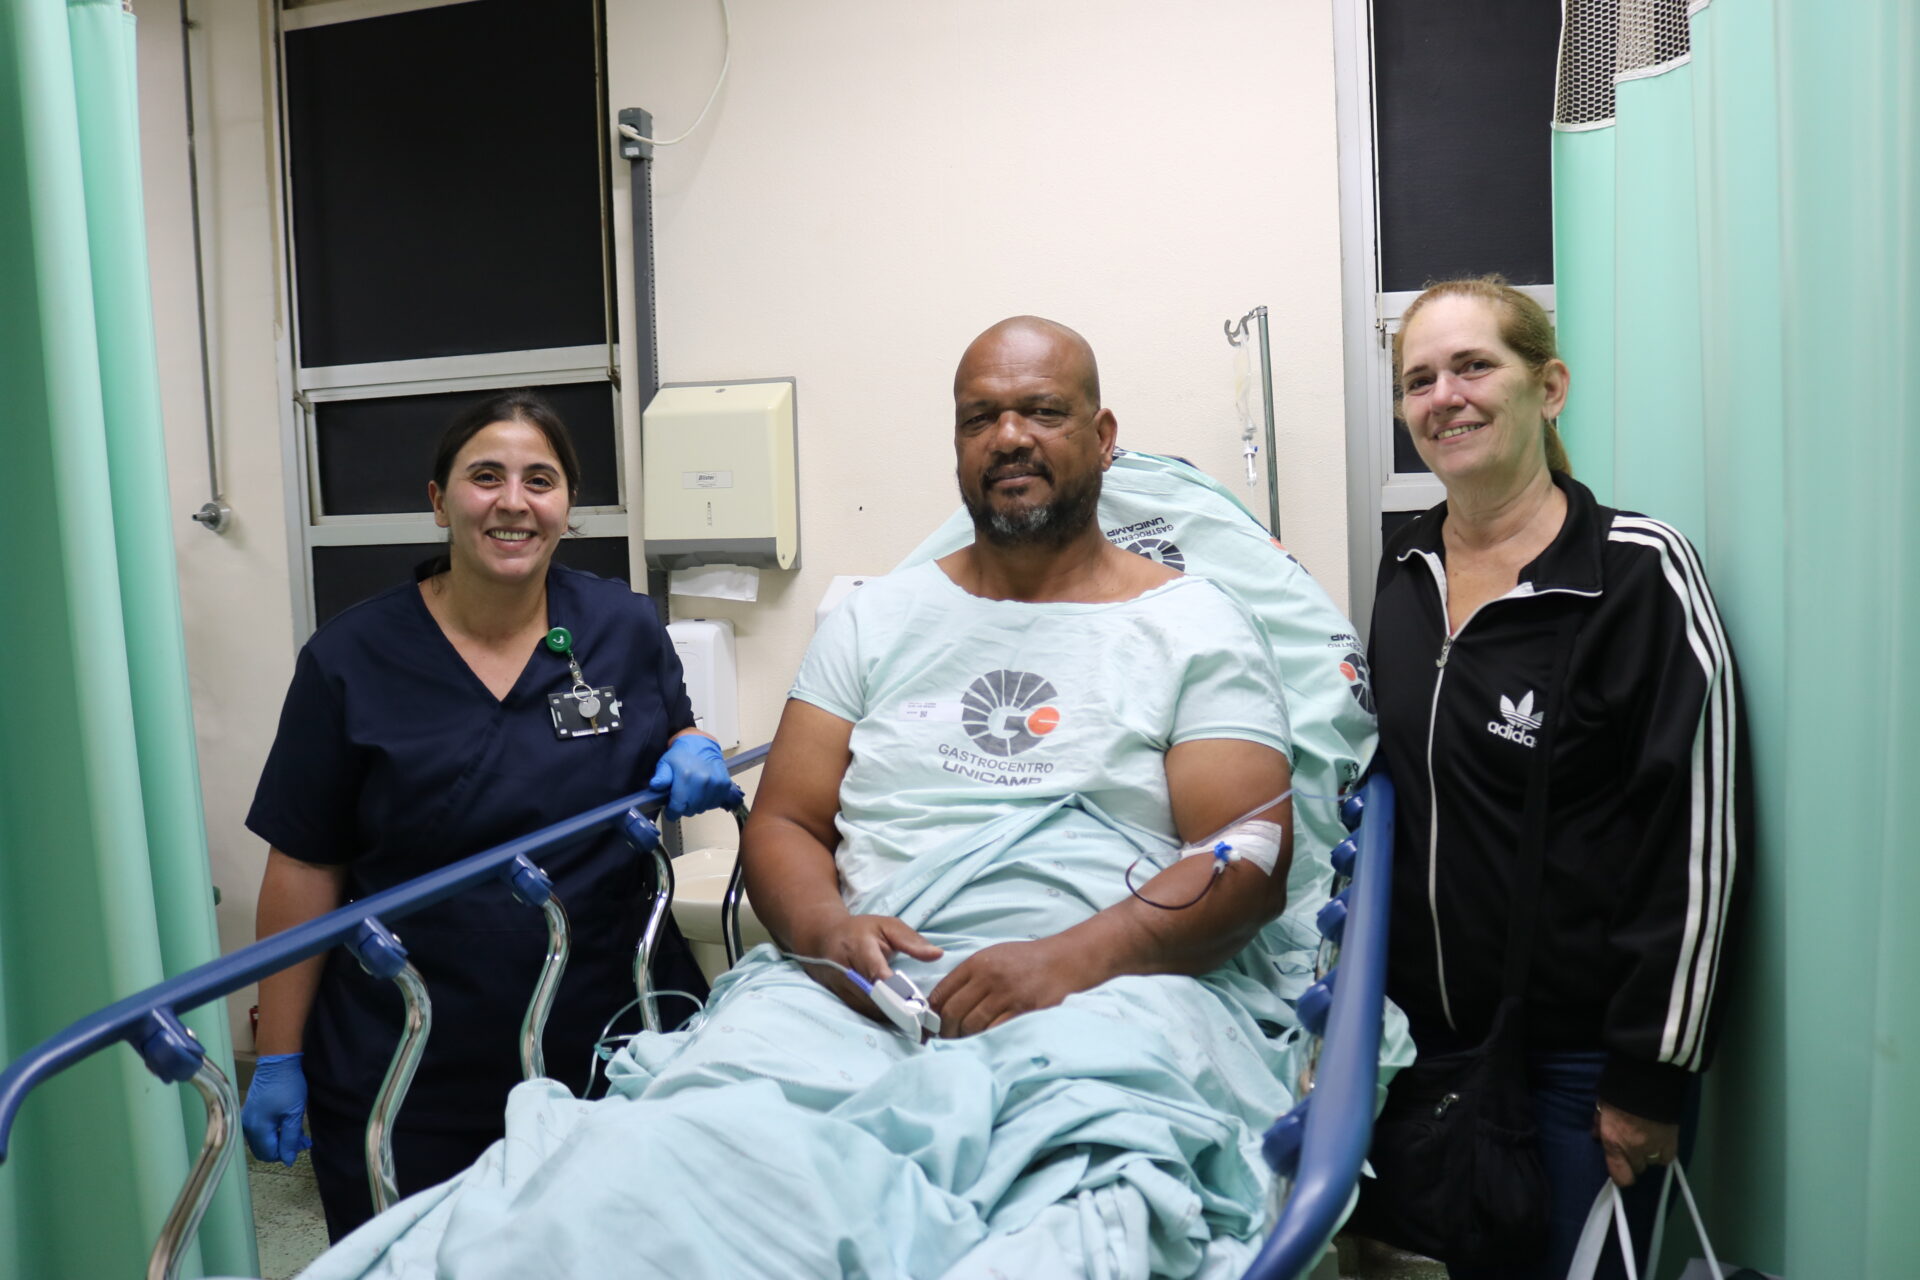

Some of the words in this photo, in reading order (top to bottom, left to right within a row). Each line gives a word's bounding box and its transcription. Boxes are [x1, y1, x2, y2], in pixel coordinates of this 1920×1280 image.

[1106, 516, 1165, 537] UNICAMP
[1110, 524, 1174, 545] GASTROCENTR
[938, 743, 1054, 774] GASTROCENTRO
[942, 760, 1042, 787] UNICAMP
